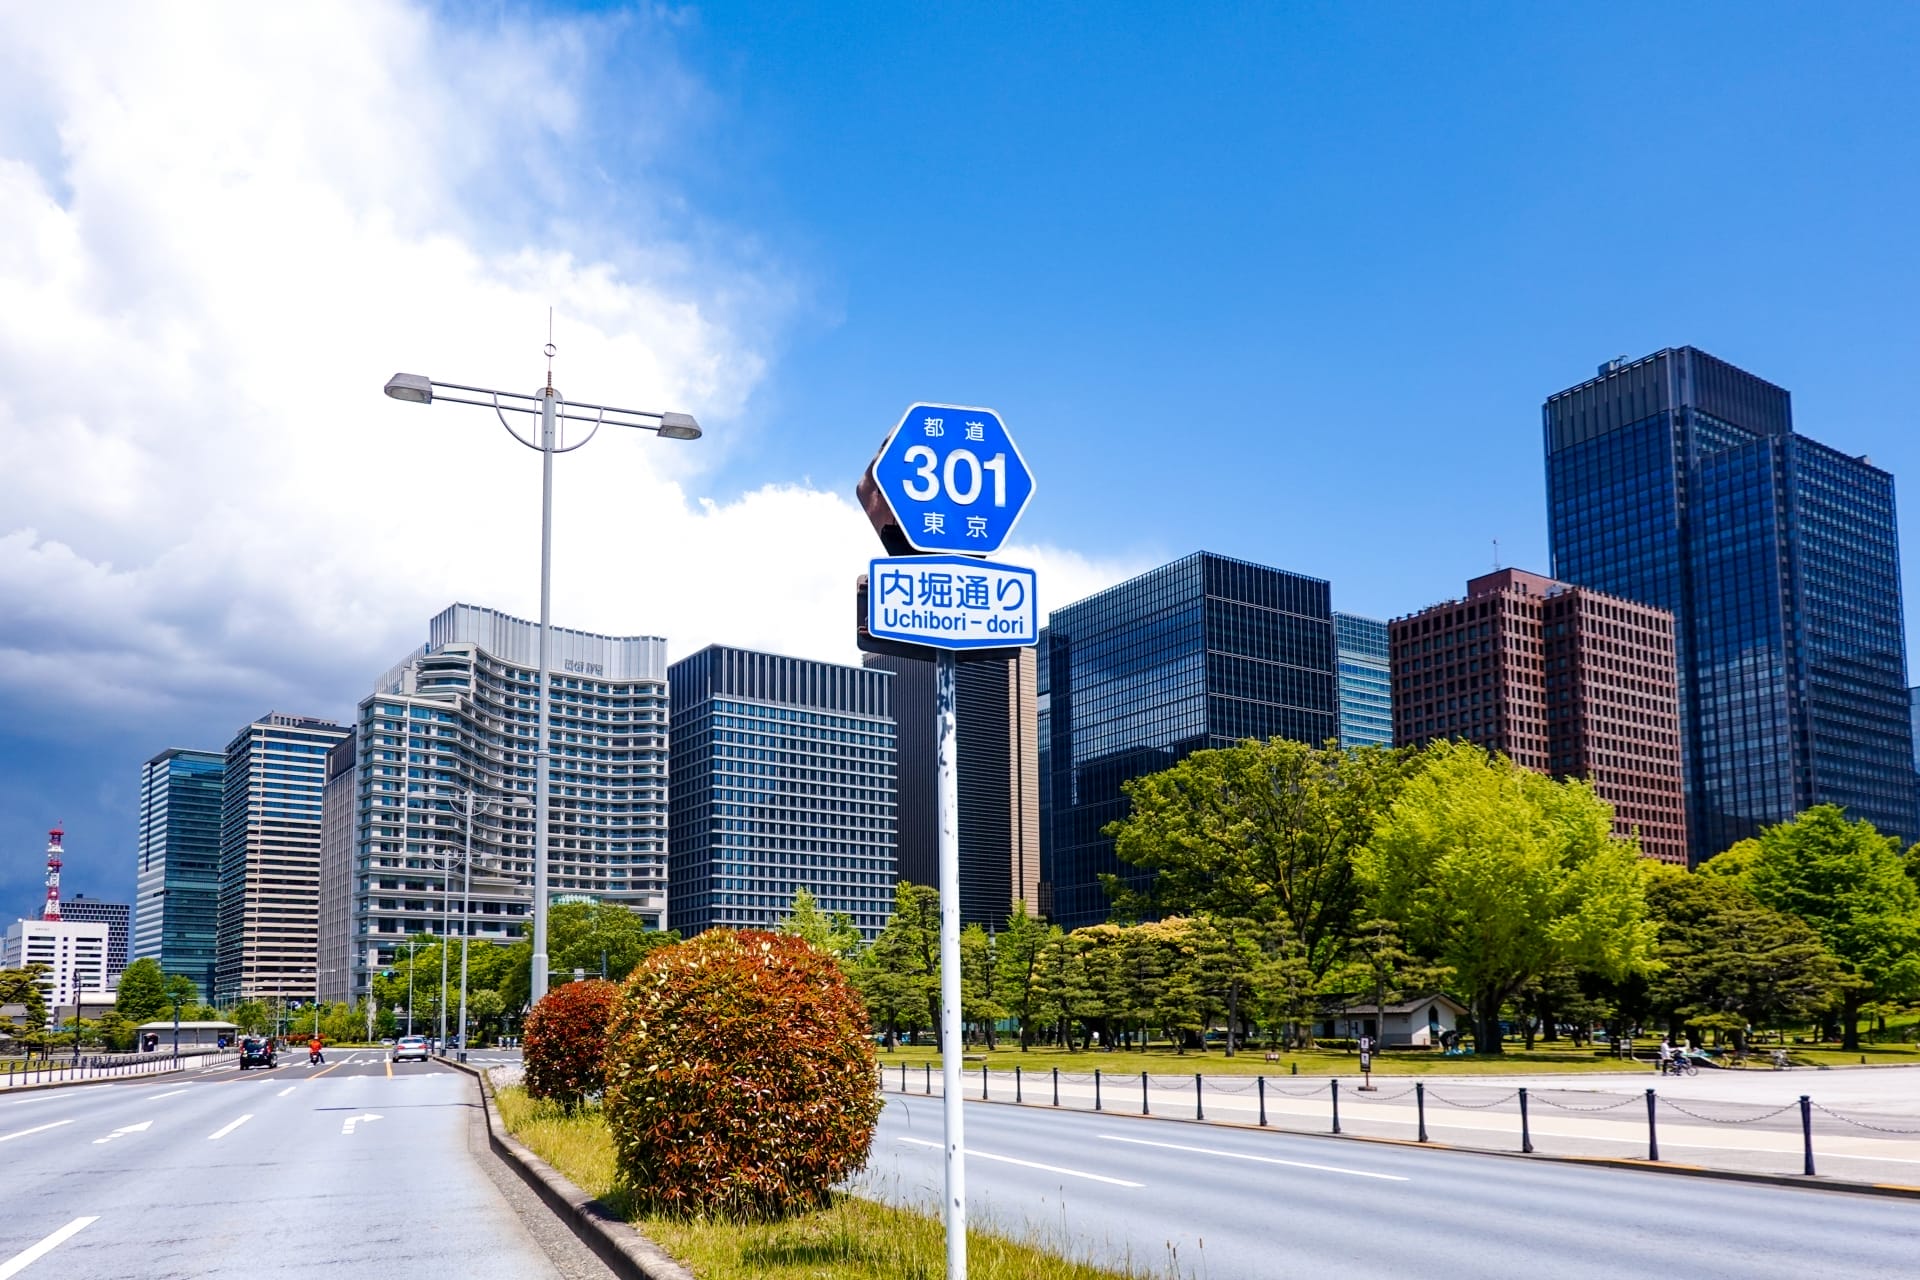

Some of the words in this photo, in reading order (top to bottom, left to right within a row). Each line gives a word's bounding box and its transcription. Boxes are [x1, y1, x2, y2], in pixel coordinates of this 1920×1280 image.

[903, 445, 1006, 507] 301
[880, 569, 1025, 611] 内堀通り
